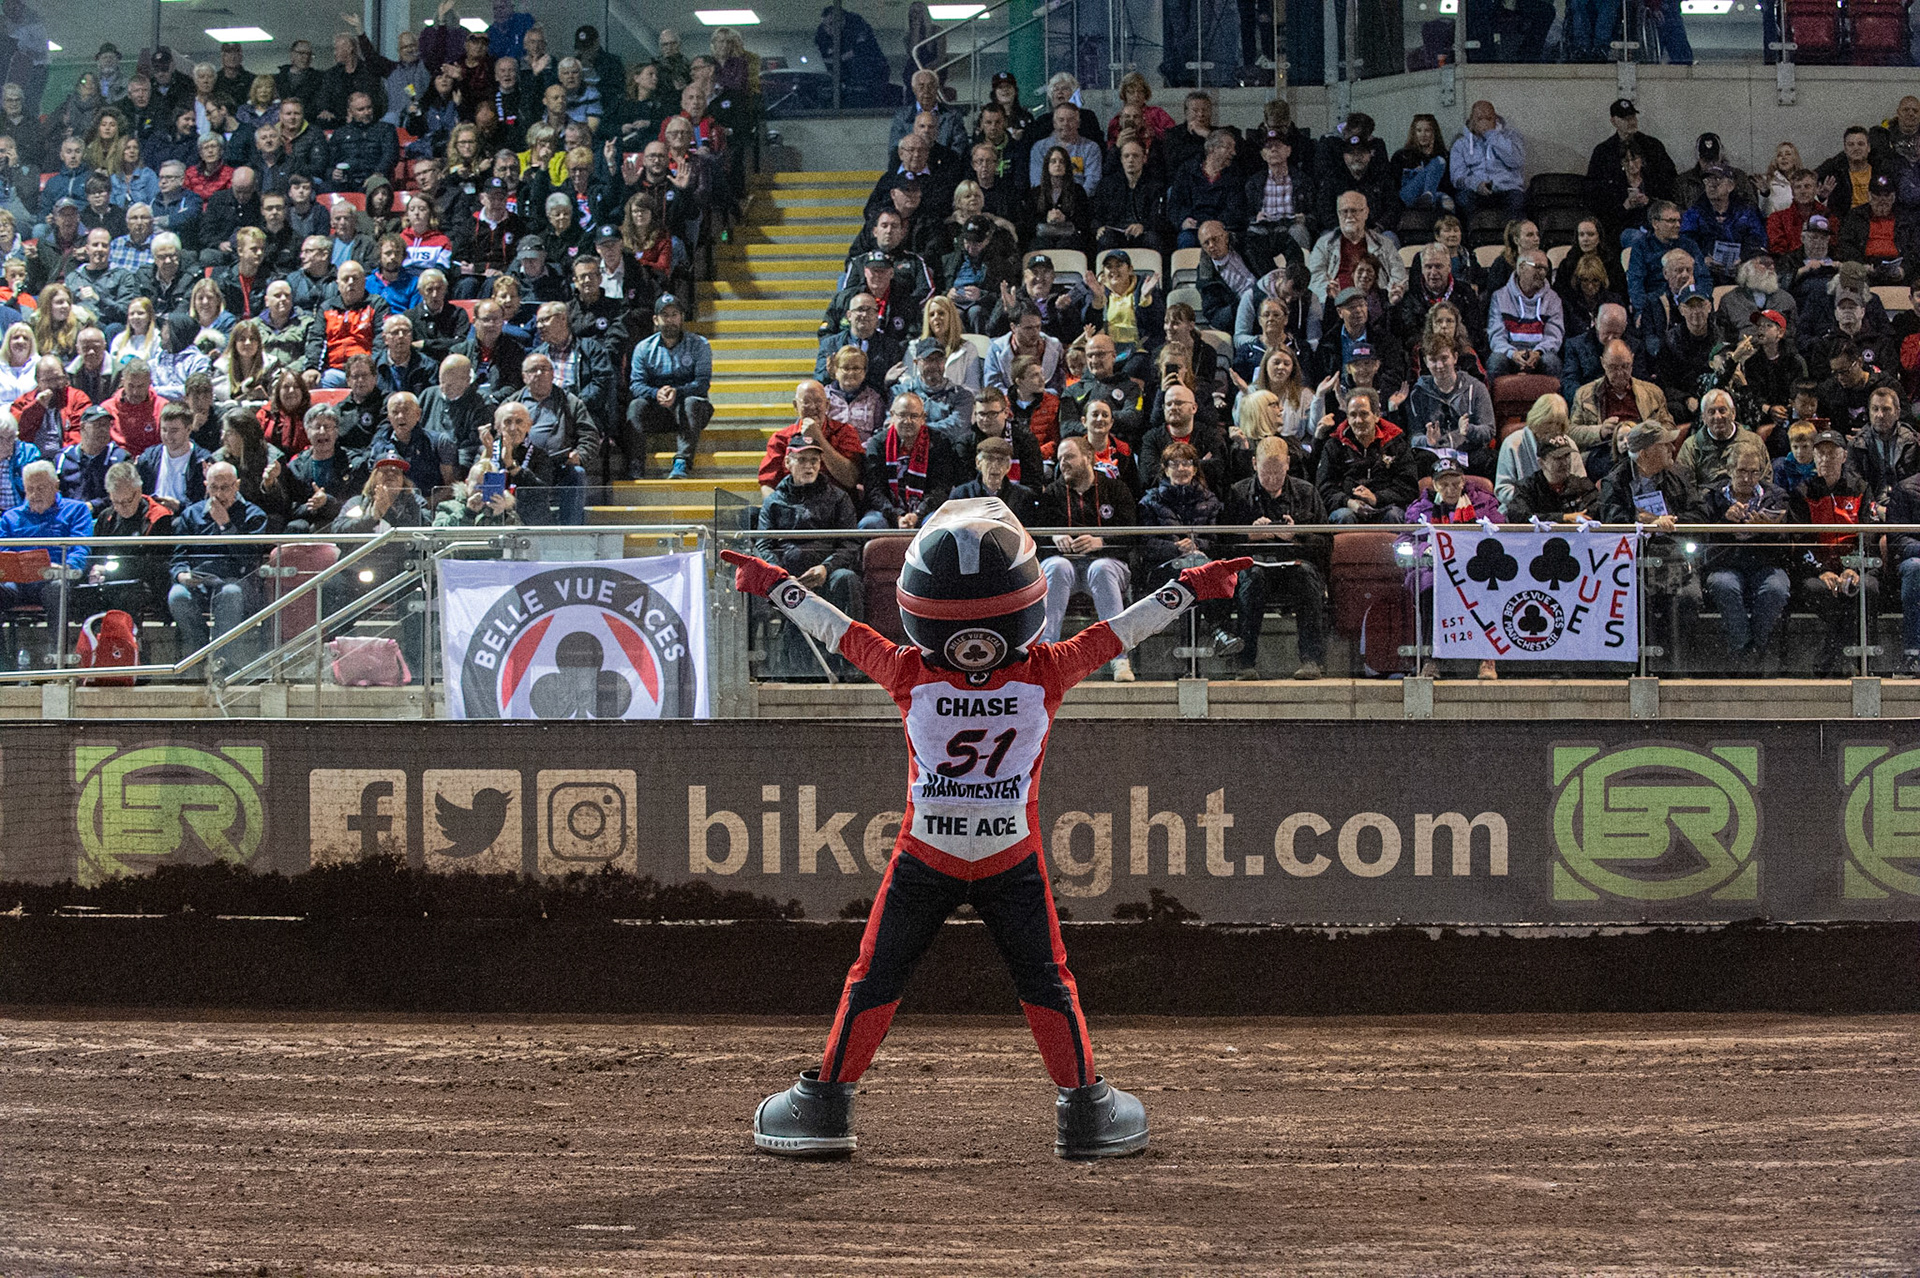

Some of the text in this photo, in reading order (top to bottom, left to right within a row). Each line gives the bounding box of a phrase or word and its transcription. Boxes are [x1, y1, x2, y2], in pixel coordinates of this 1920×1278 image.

[1436, 532, 1634, 655] BELLE VUE ACES
[474, 577, 686, 670] BELLE VUE ACES
[1441, 616, 1465, 628] EST
[1504, 591, 1564, 629] BELLE VUE ACES
[1443, 631, 1473, 644] 1928
[1504, 621, 1559, 651] MANCHESTER
[936, 697, 1018, 717] CHASE
[922, 773, 1021, 799] MANCHESTER
[924, 815, 1017, 836] THE ACE
[688, 784, 1508, 897] bikeght.com
